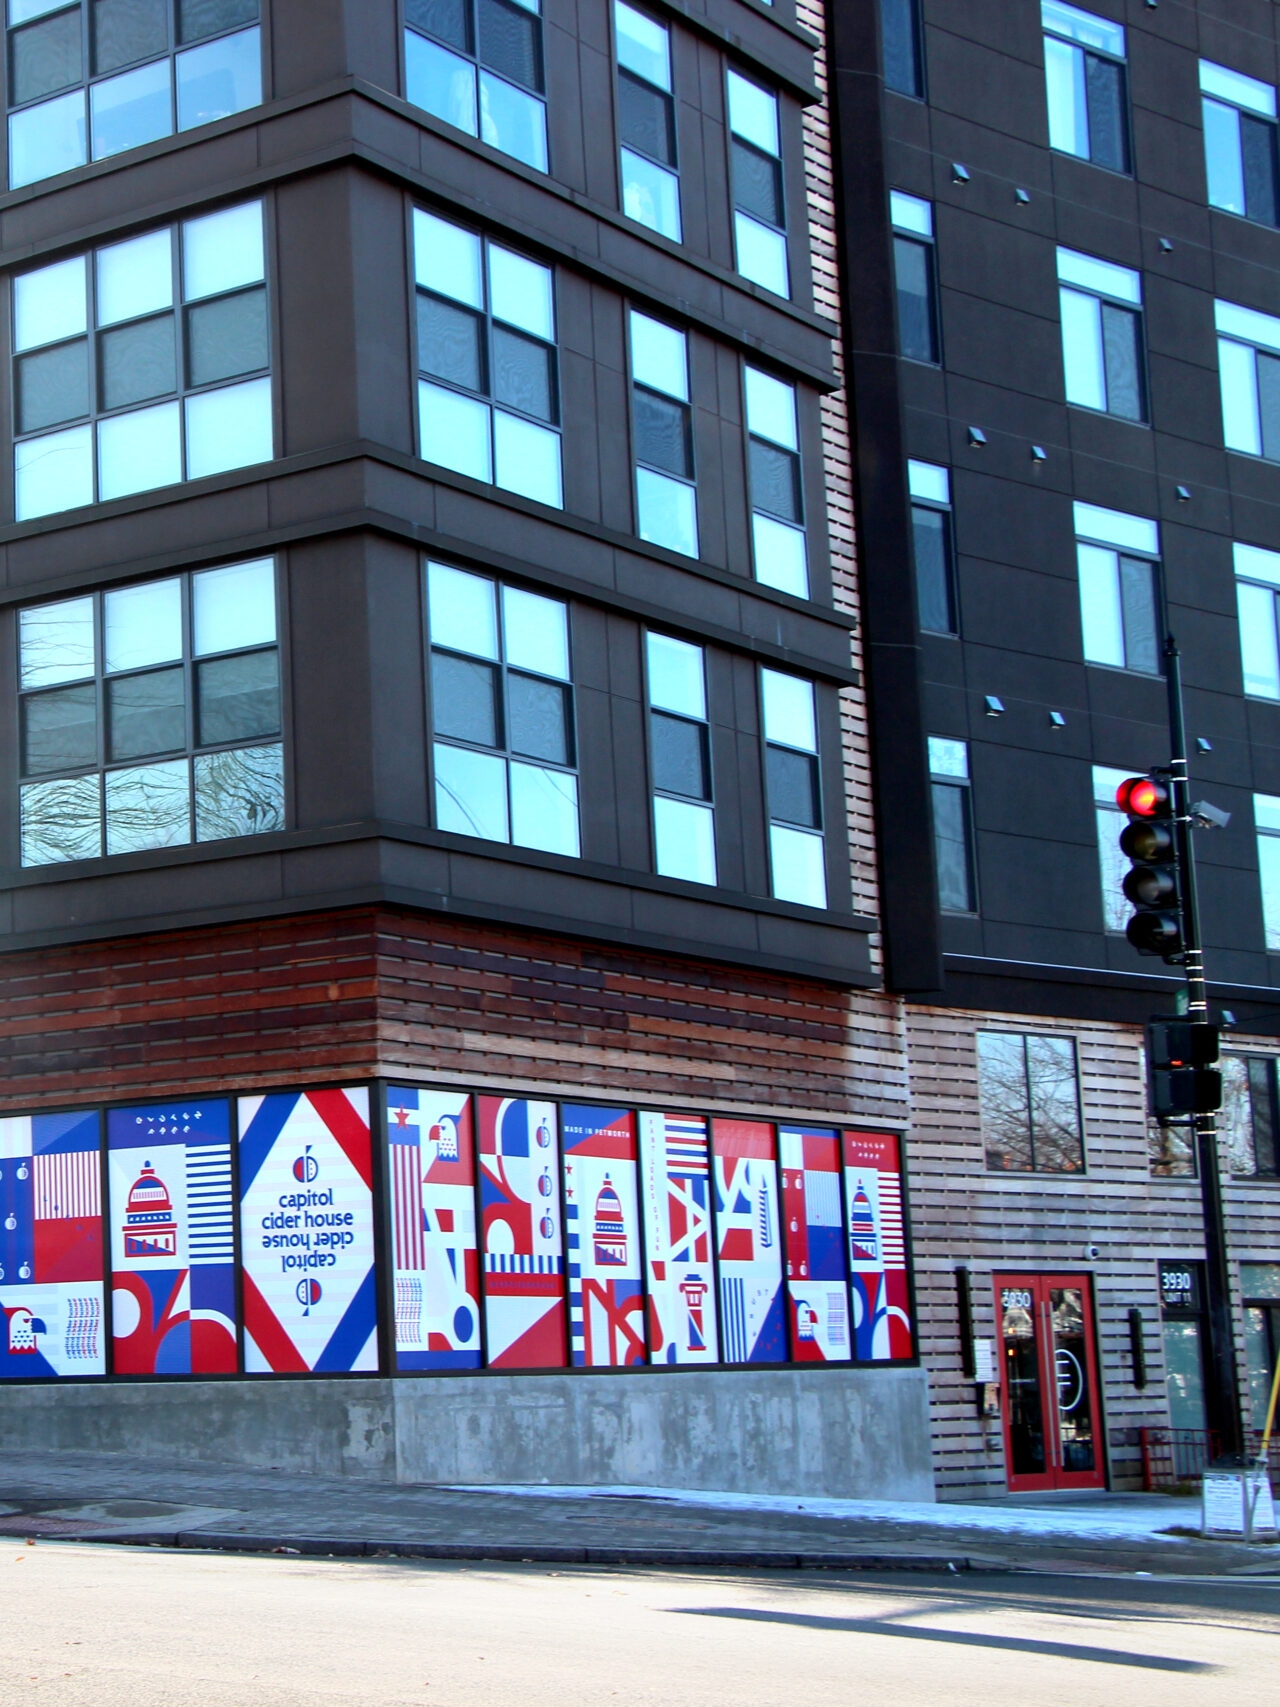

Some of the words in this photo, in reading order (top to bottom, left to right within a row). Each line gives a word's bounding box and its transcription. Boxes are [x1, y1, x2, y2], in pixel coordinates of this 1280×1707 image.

[563, 1125, 583, 1134] MADE
[594, 1128, 631, 1139] PETWORTH
[278, 1188, 334, 1211] capitol
[261, 1211, 301, 1230] cider
[304, 1210, 354, 1228] house
[261, 1233, 311, 1251] house
[313, 1231, 354, 1250] cider
[280, 1249, 337, 1273] capitol
[1161, 1272, 1191, 1290] 3930
[1002, 1291, 1031, 1307] 3930
